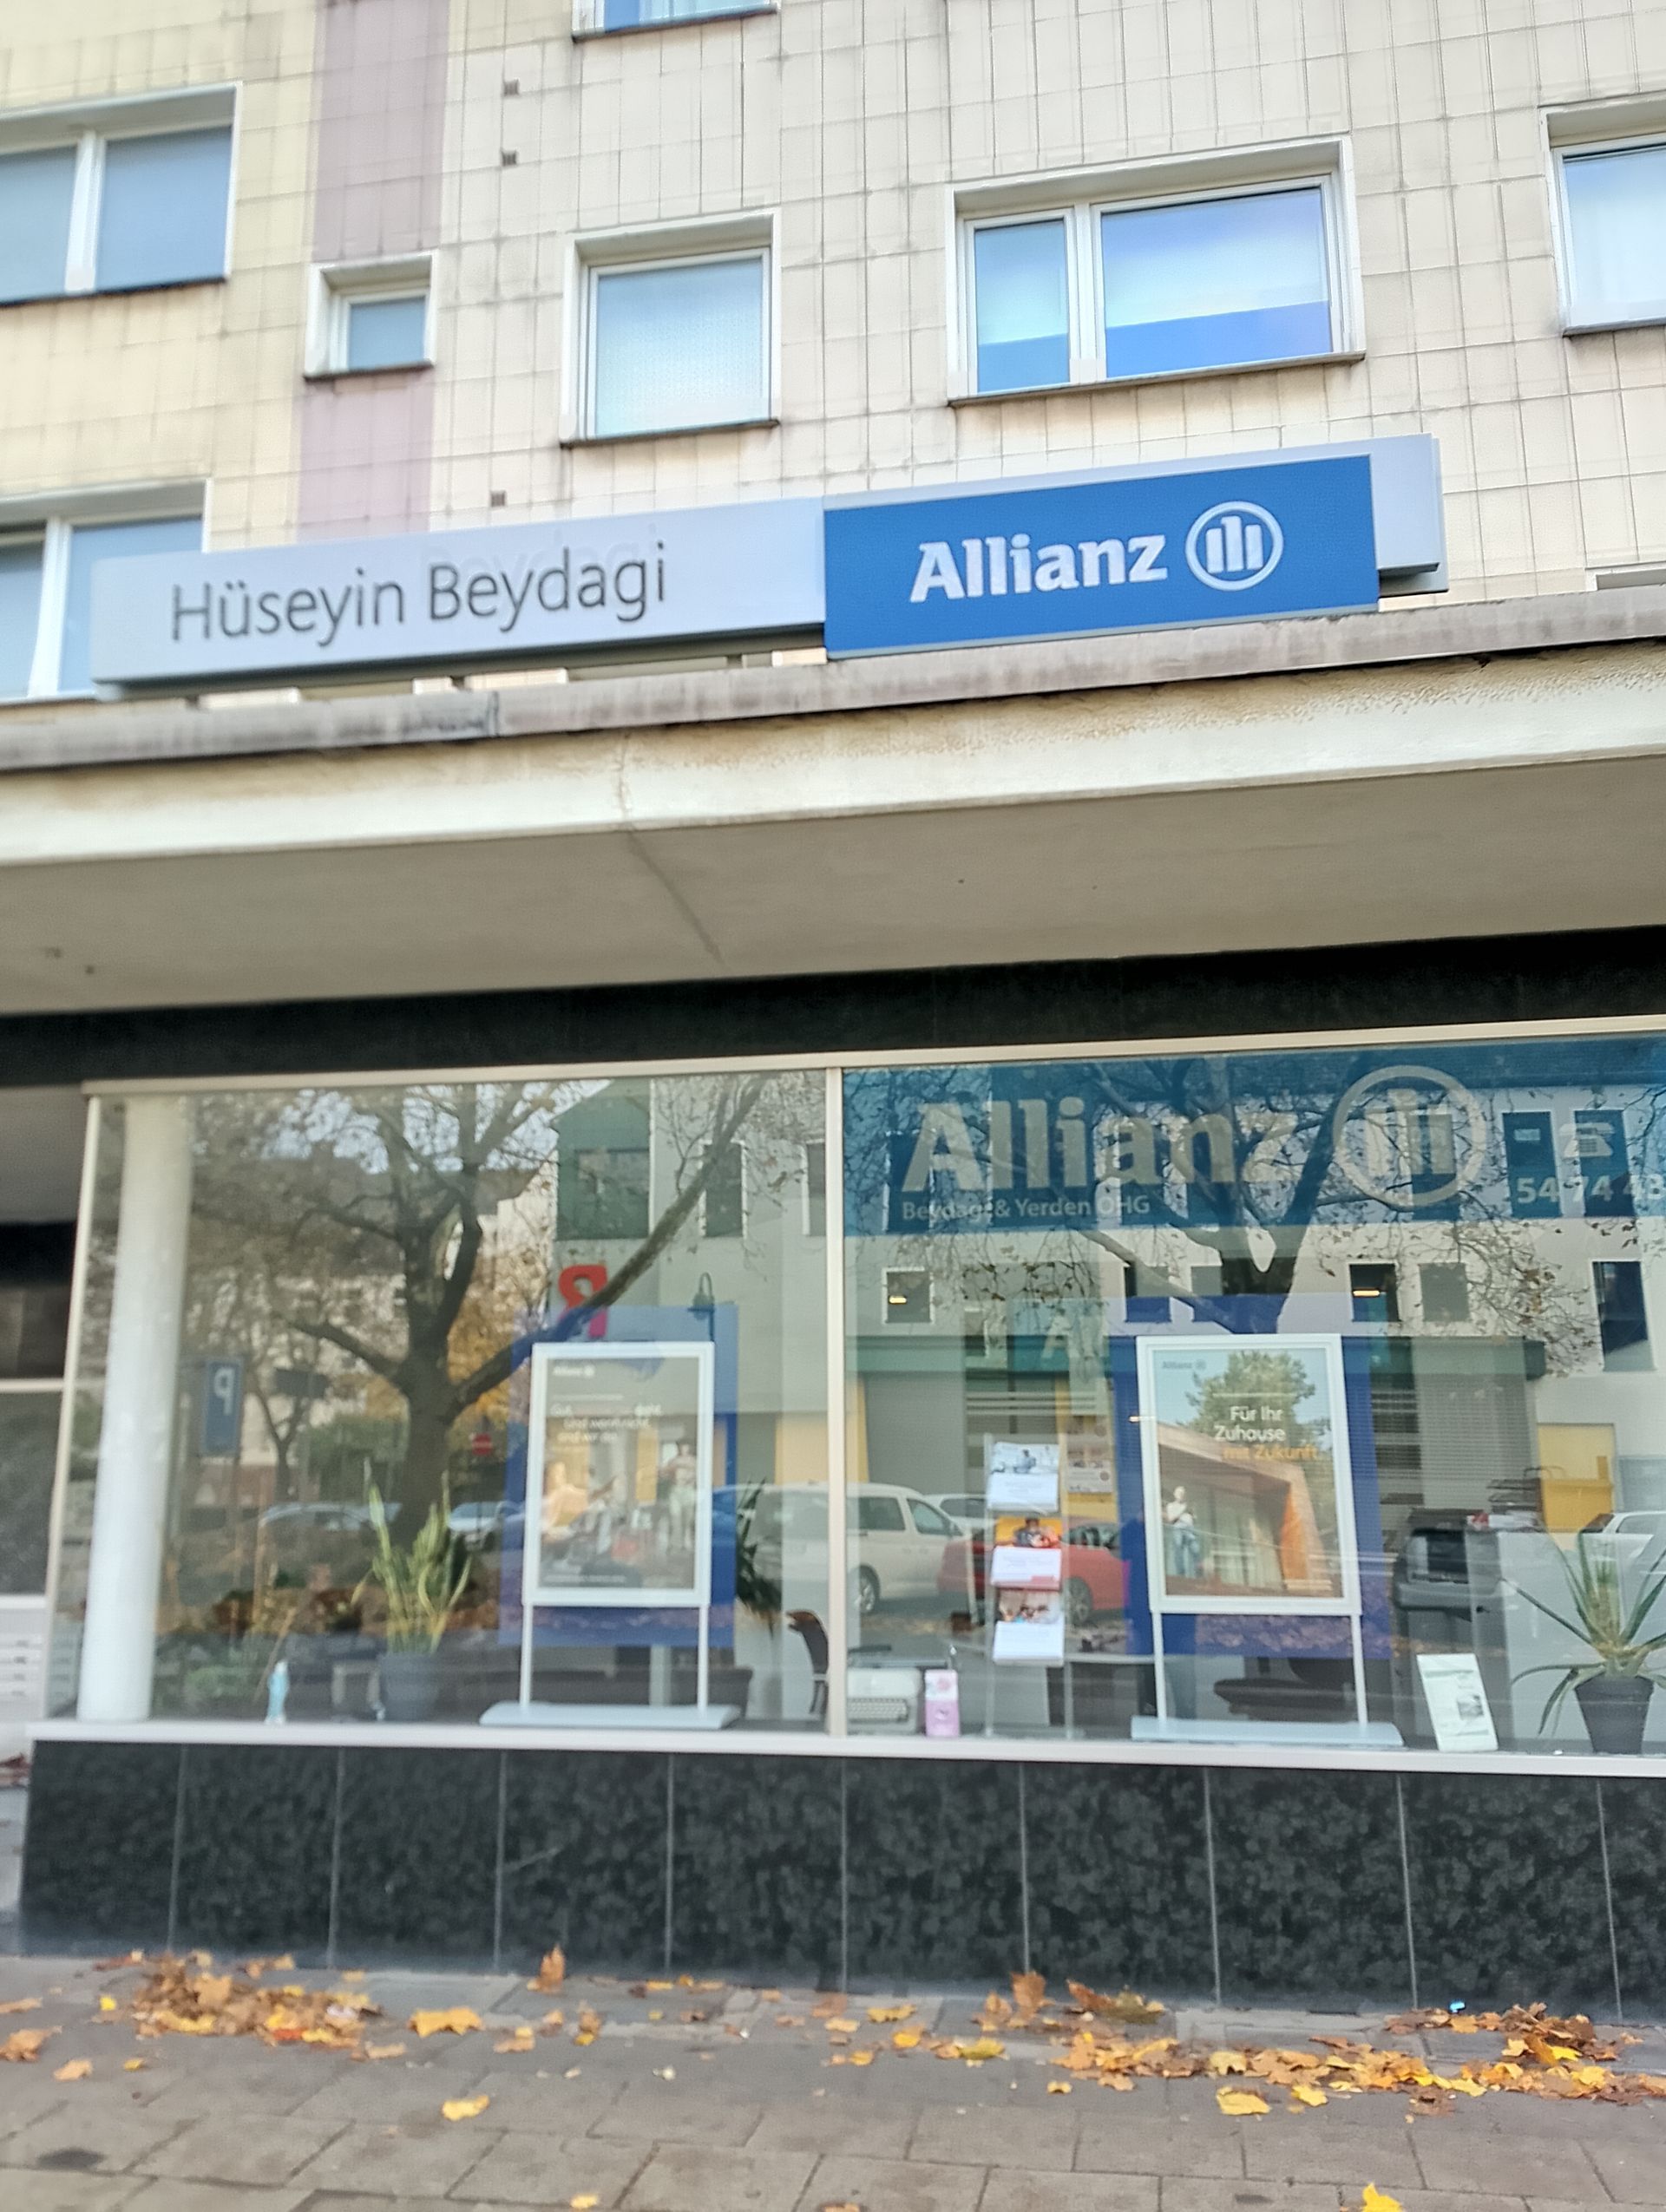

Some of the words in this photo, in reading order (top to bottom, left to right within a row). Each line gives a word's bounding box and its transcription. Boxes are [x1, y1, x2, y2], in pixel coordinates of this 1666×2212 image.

[909, 533, 1168, 604] Allianz
[171, 566, 406, 647] Hüseyin
[428, 540, 666, 633] Beydagi
[902, 1096, 1301, 1193] Allianz
[994, 1199, 1011, 1218] &
[1014, 1197, 1092, 1217] Yerden
[1097, 1194, 1151, 1215] OHG
[1213, 1424, 1287, 1443] Zuhause
[1230, 1405, 1257, 1422] Für
[1261, 1405, 1283, 1422] Ihr
